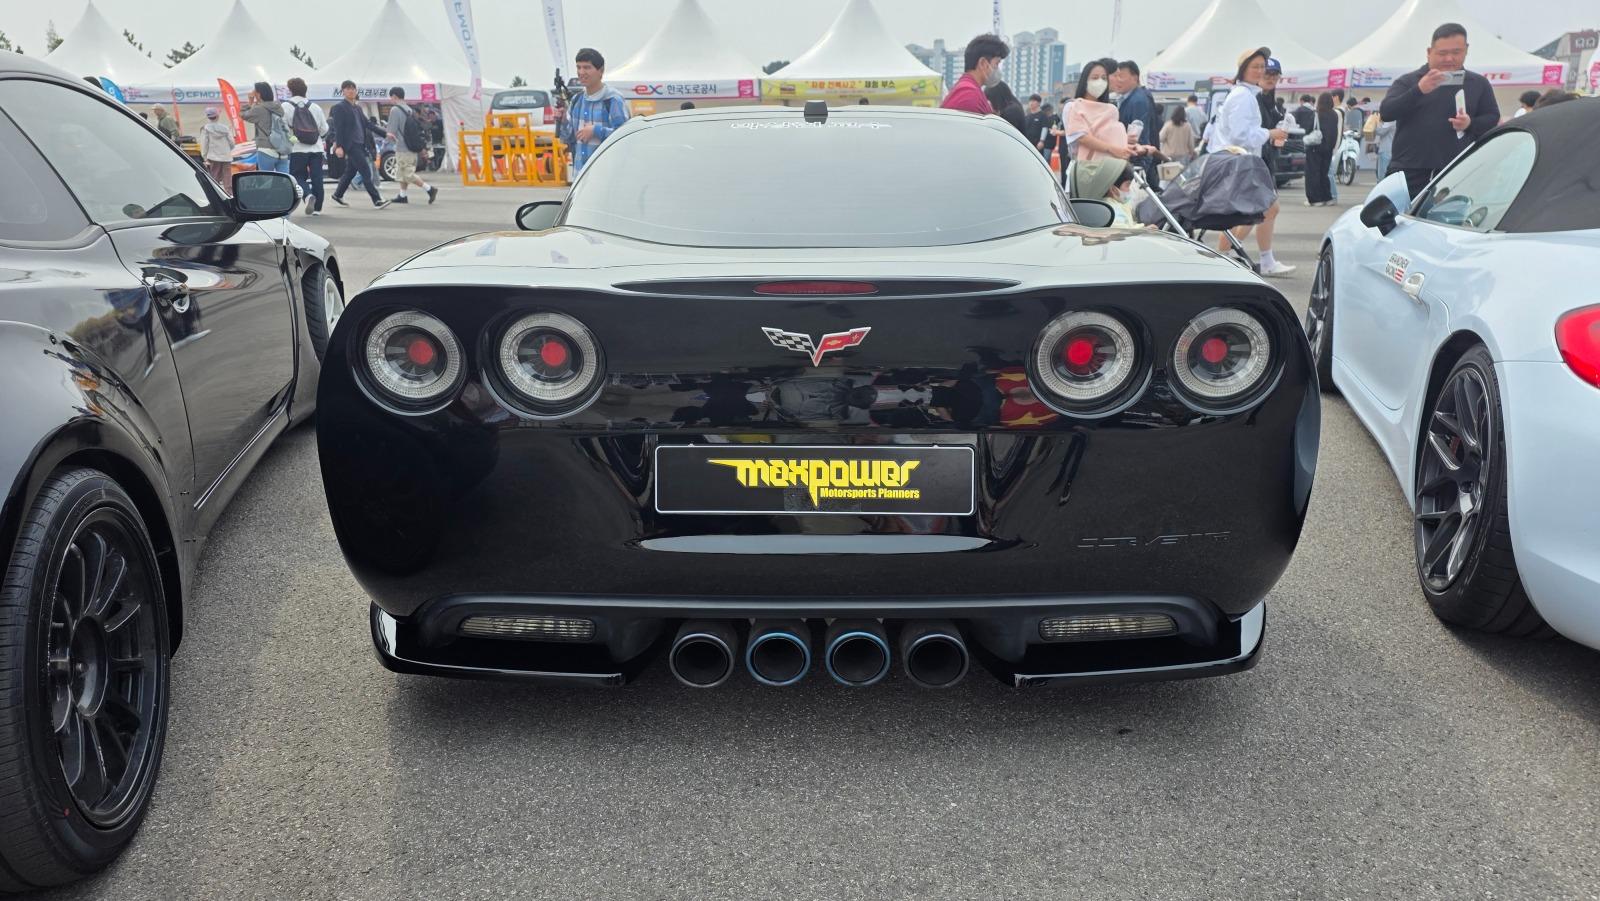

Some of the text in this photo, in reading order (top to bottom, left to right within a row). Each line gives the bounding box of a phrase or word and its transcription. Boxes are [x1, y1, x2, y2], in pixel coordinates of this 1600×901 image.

[631, 84, 664, 96] ex
[819, 487, 920, 500] Motorsports Planners
